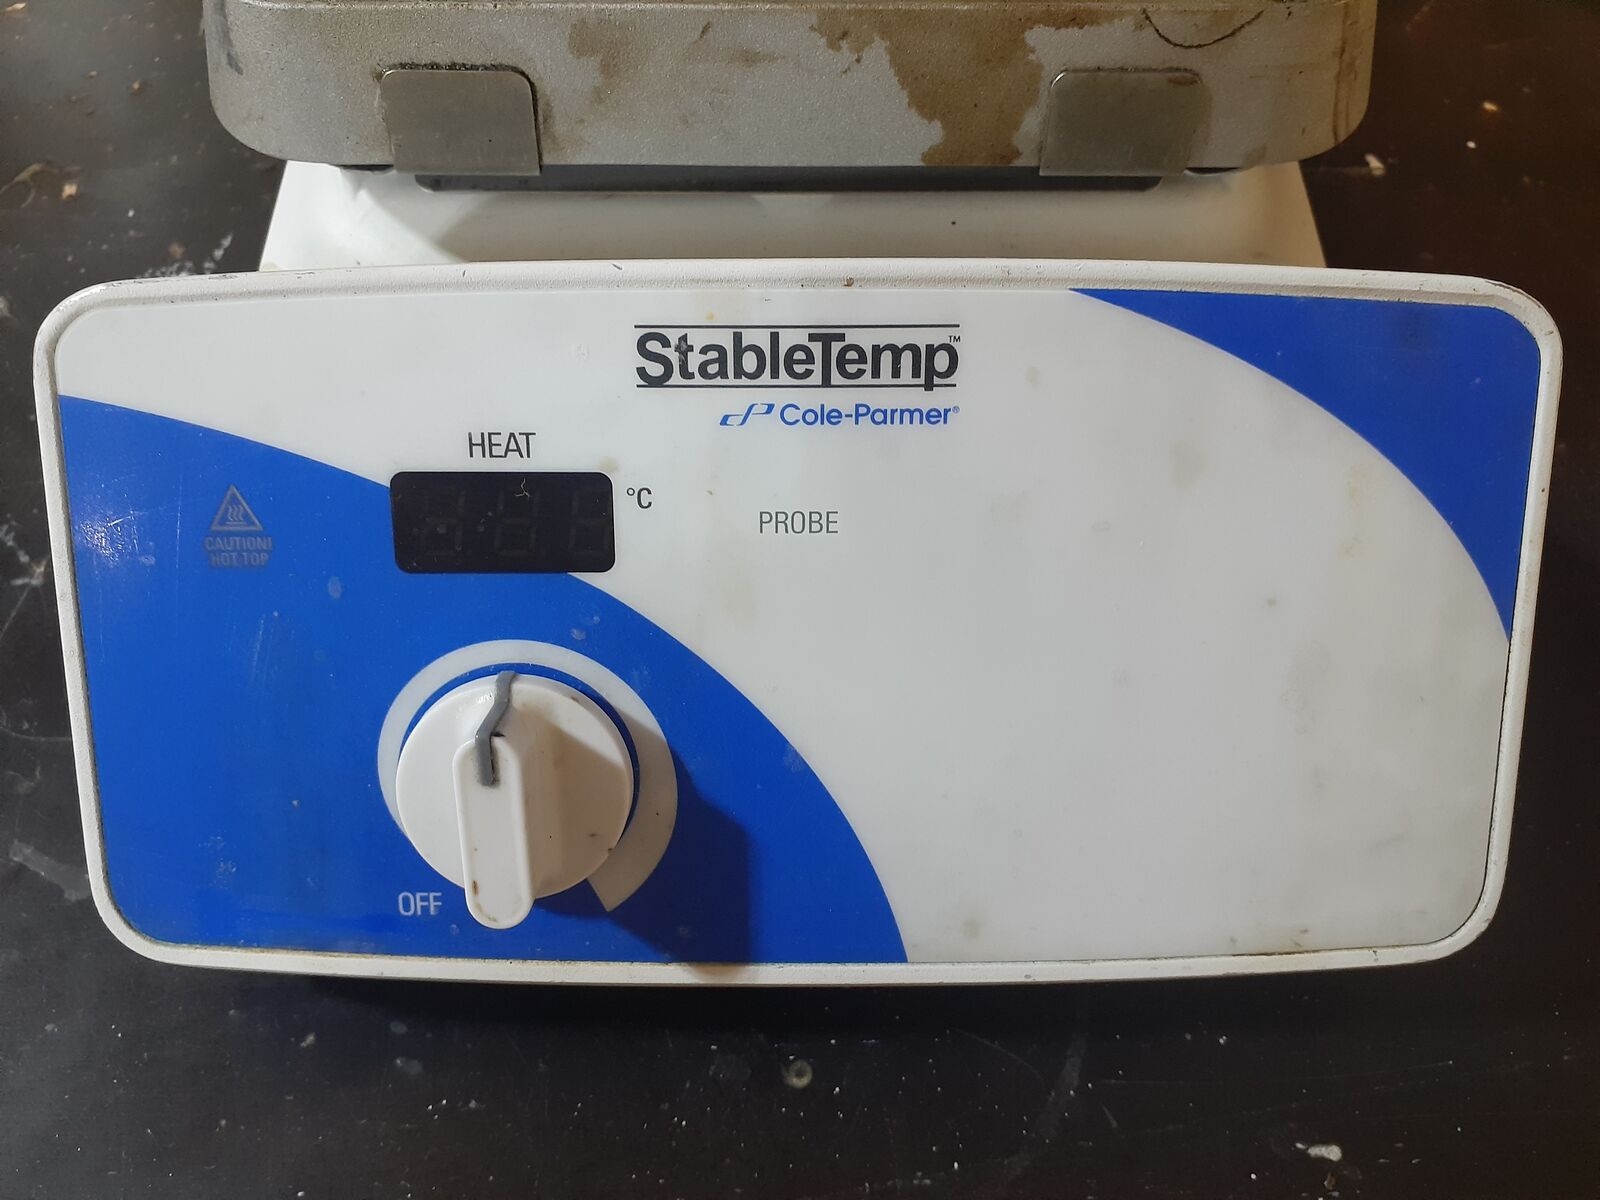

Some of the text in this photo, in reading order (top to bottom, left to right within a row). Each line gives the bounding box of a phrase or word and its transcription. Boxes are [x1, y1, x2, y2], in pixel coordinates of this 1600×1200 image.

[468, 432, 536, 458] HEAT
[626, 487, 652, 509] °C
[759, 511, 839, 534] PROBE
[204, 536, 273, 551] CAUTION!
[210, 552, 269, 567] HOT TOP
[398, 892, 442, 916] OFF
